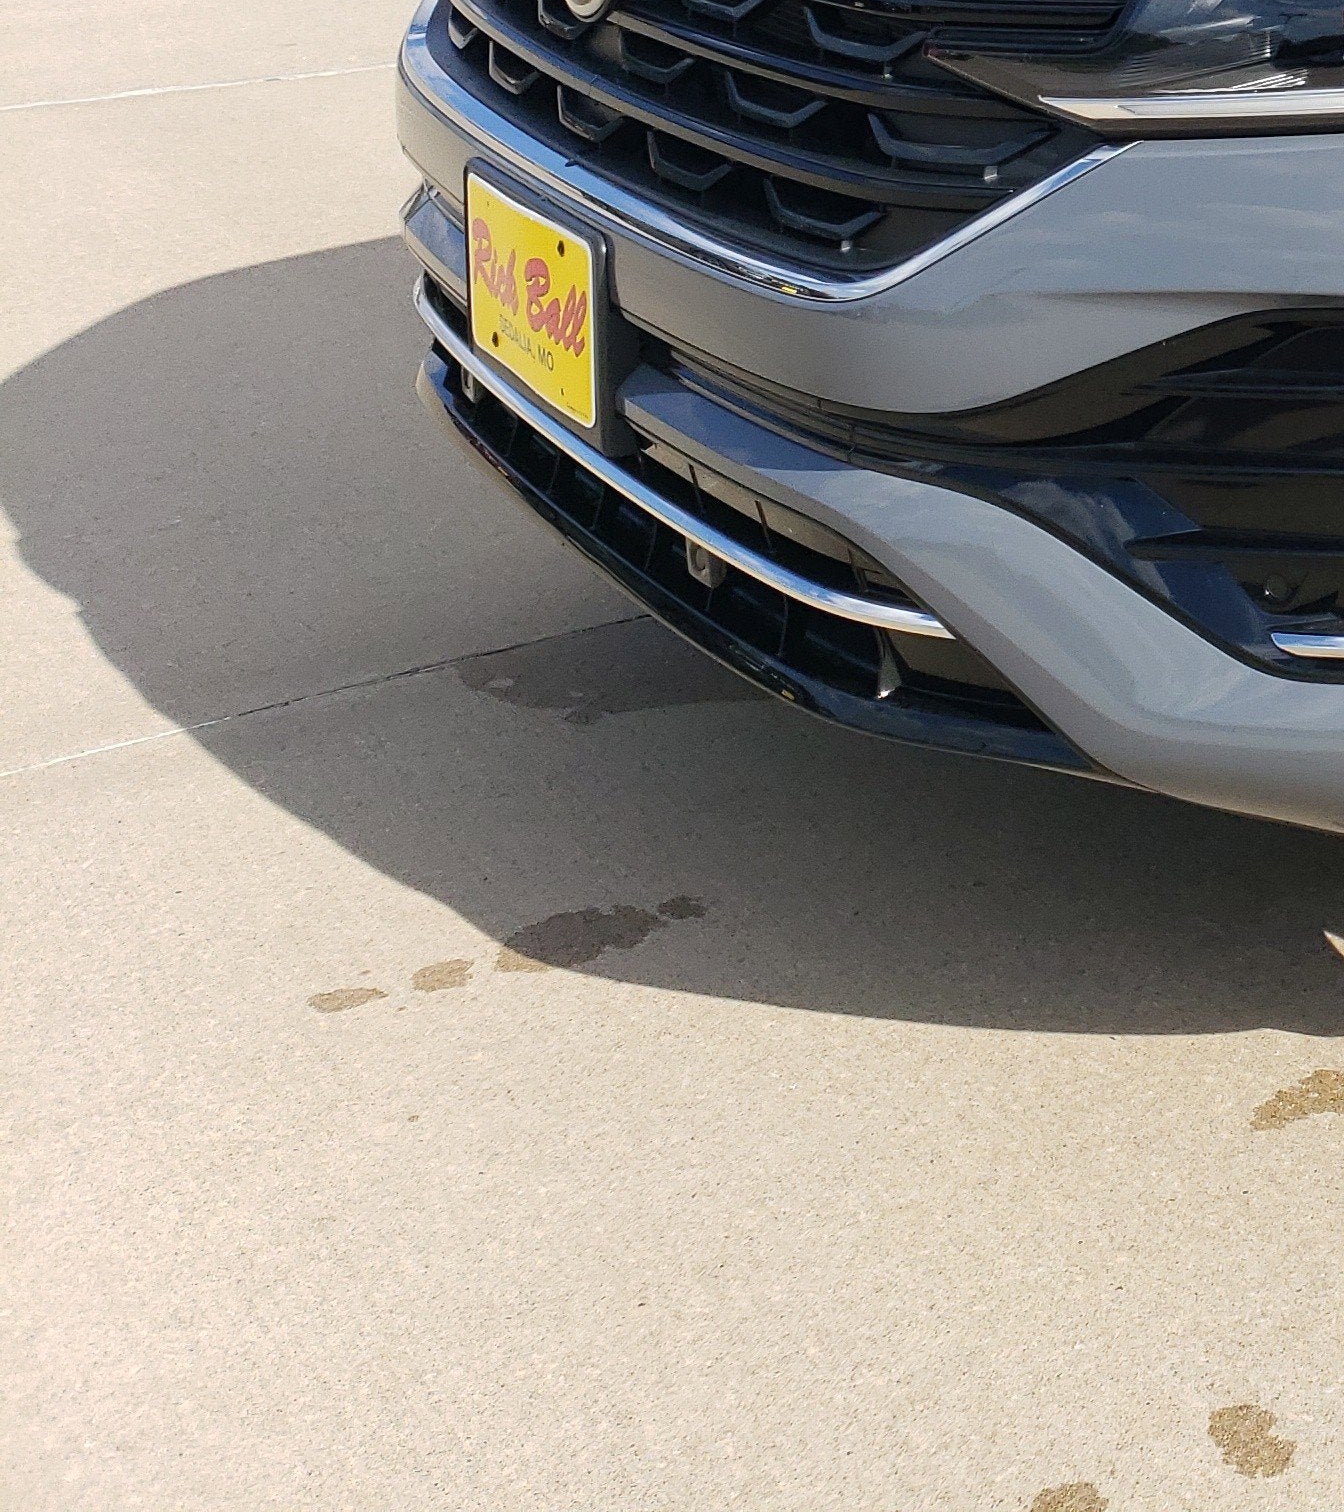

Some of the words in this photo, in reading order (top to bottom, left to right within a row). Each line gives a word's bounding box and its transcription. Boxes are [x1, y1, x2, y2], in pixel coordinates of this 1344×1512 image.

[473, 217, 519, 316] Rick
[524, 257, 587, 357] Ball
[538, 343, 554, 372] MO
